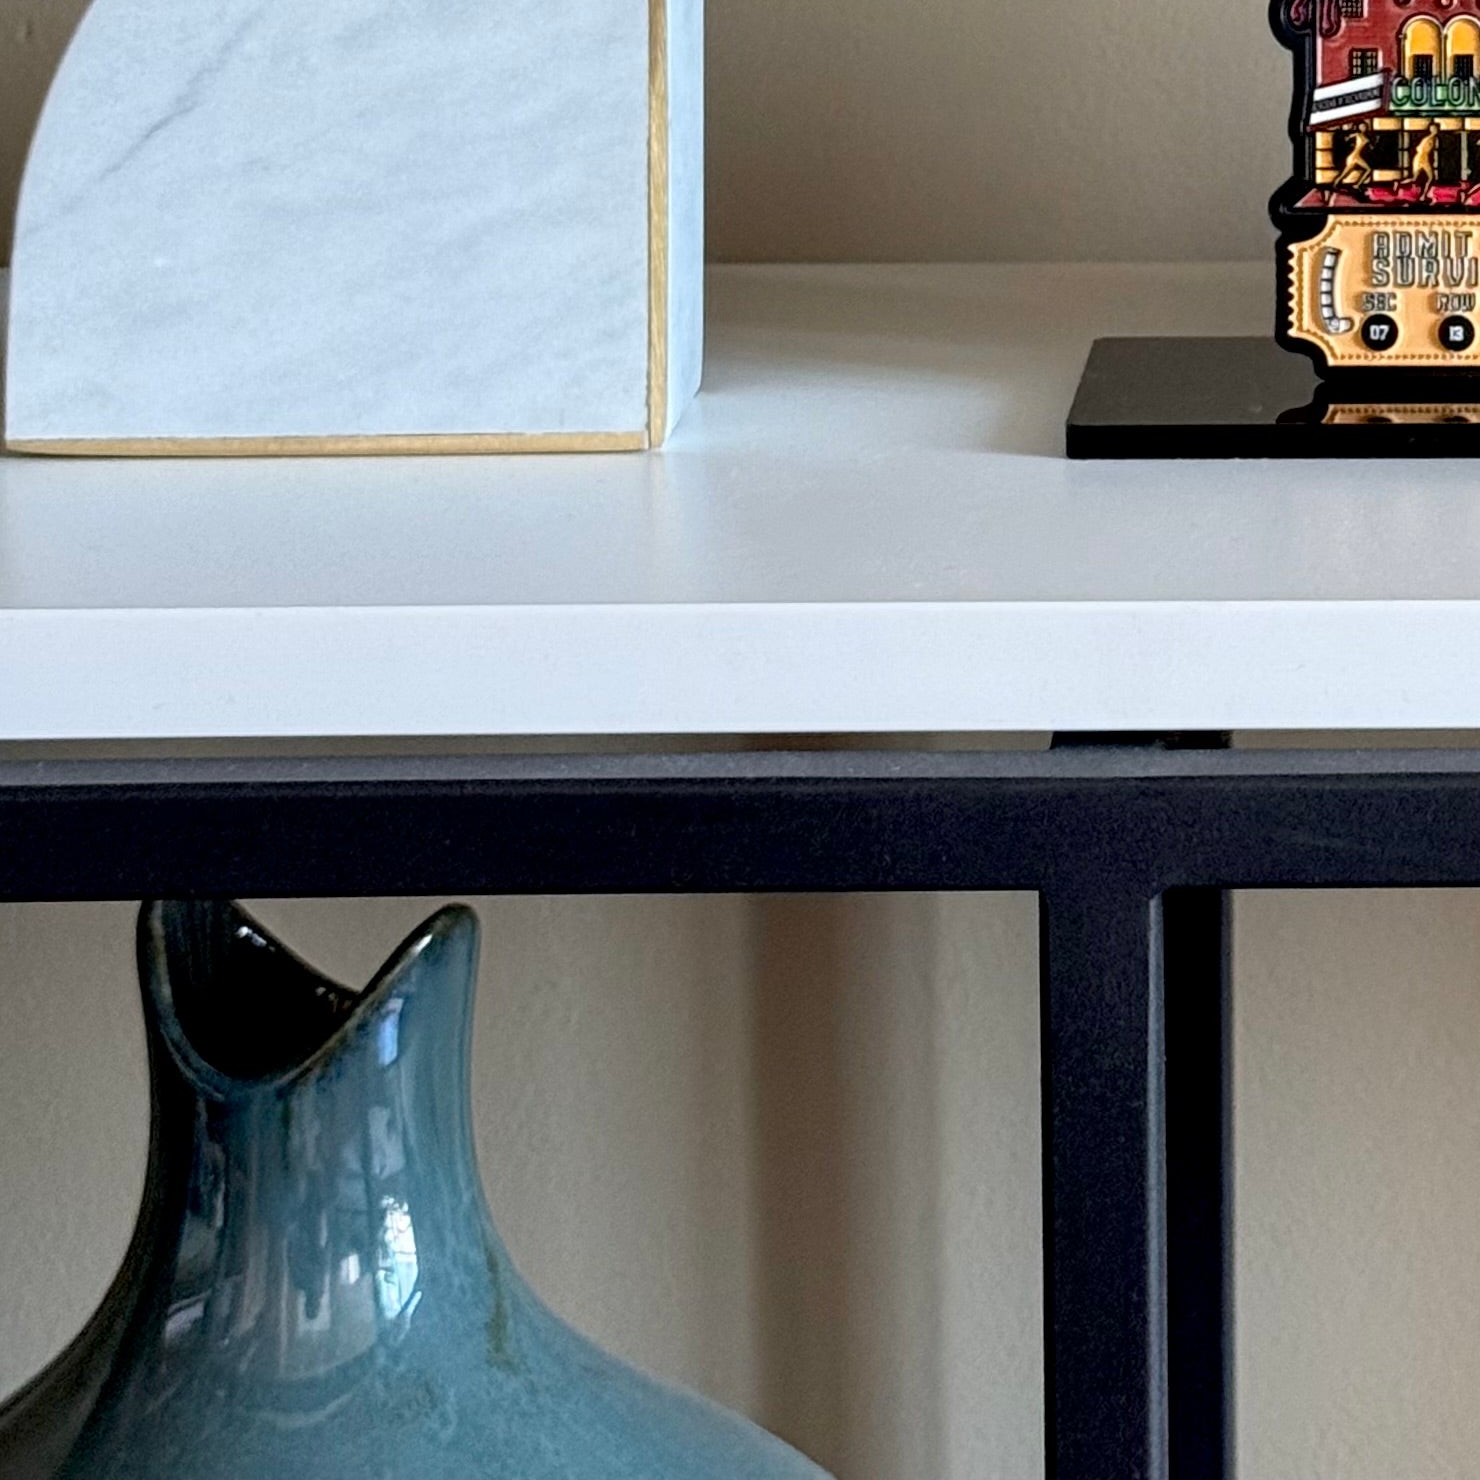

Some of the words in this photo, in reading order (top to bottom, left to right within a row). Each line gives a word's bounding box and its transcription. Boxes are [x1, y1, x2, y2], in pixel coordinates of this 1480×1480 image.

[1372, 231, 1472, 259] ADMIT
[1362, 292, 1398, 312] SEC
[1437, 292, 1477, 312] ROW
[1369, 324, 1390, 341] 07
[1449, 325, 1465, 342] 13
